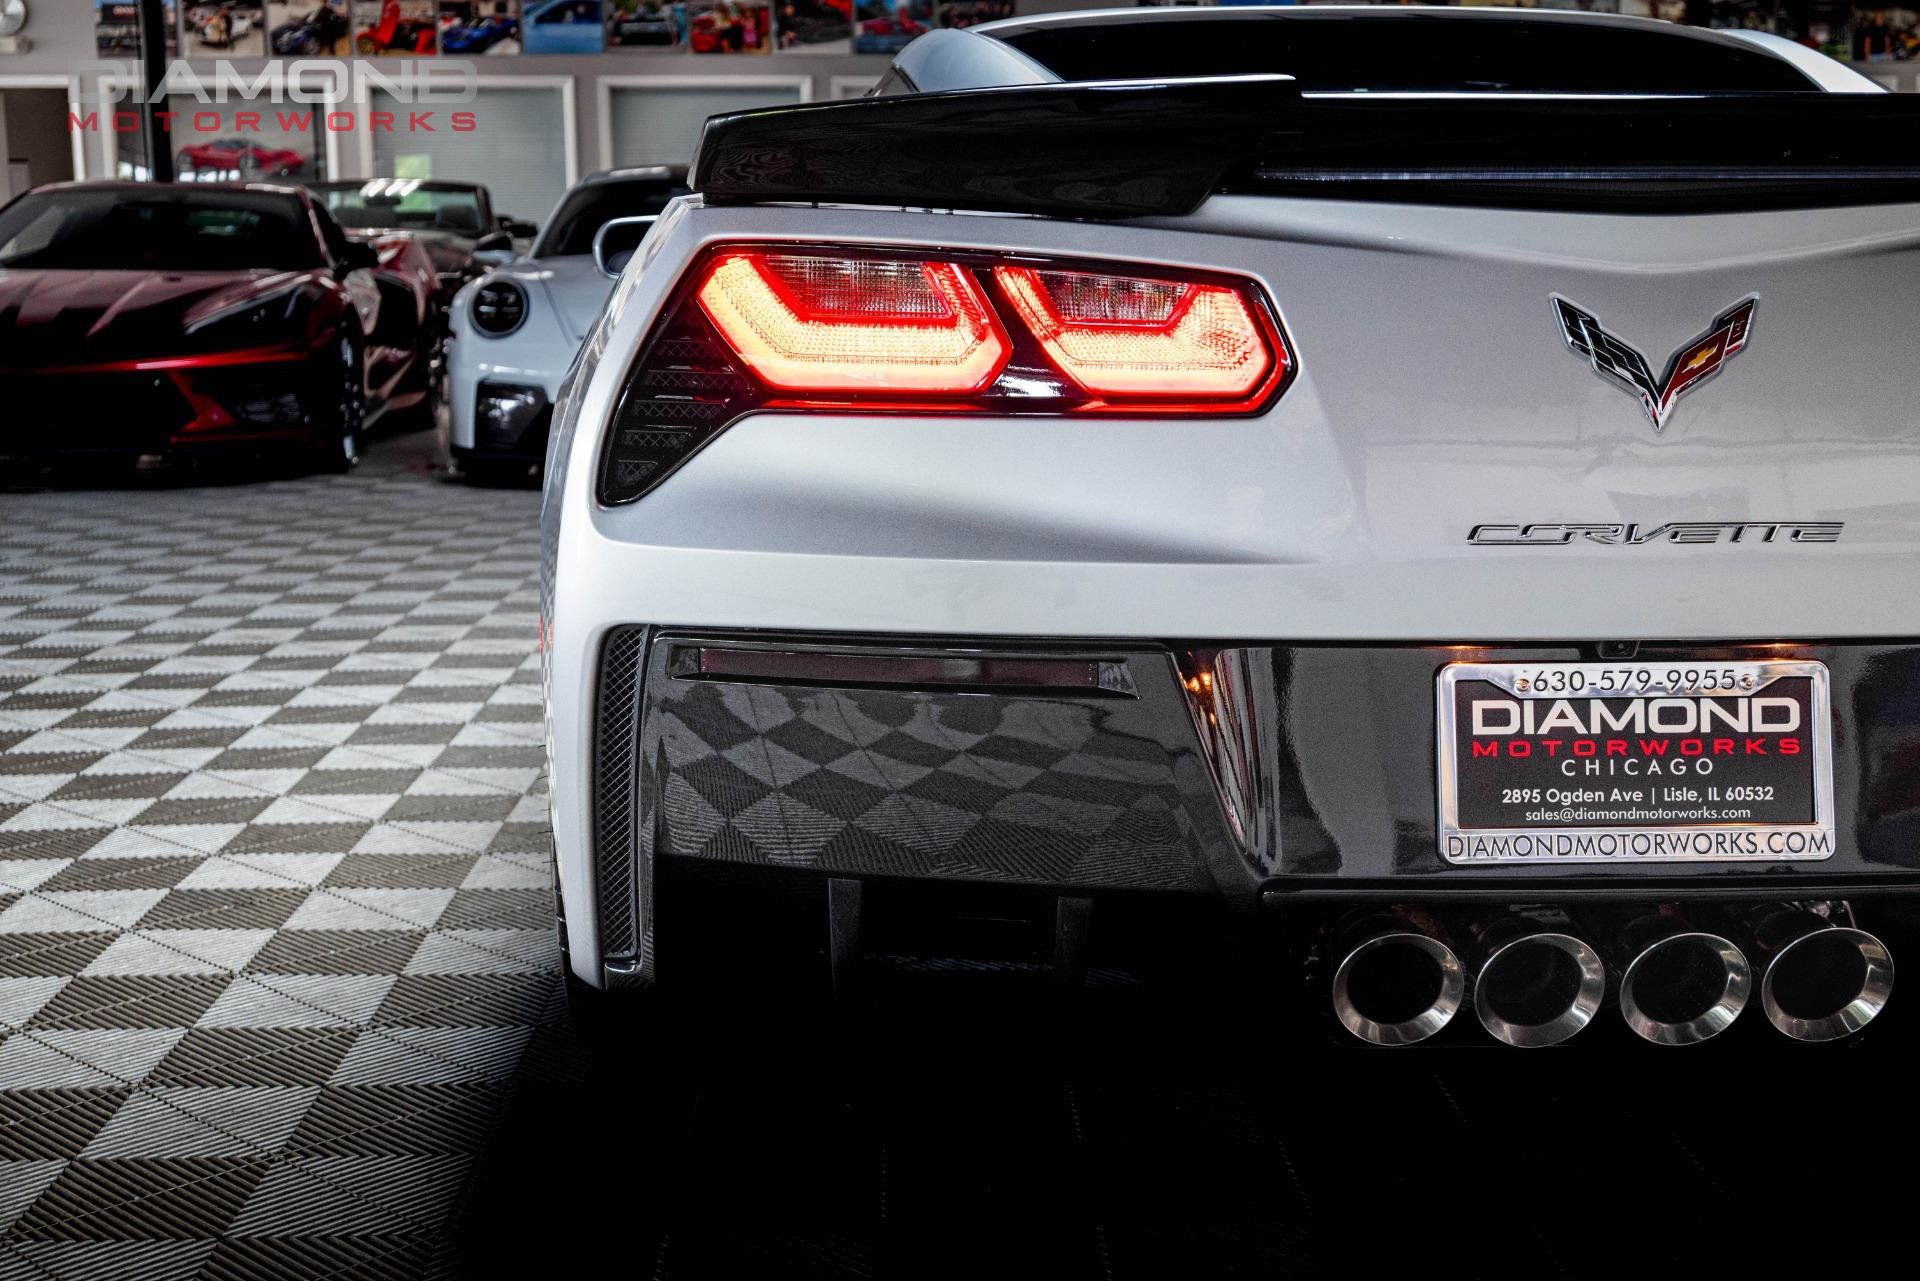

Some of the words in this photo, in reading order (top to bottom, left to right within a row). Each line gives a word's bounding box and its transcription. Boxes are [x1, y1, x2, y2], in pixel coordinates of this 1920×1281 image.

[1466, 522, 1845, 545] CORVETTE
[1533, 669, 1737, 692] 630-579-9955
[1472, 697, 1801, 735] DIAMOND
[1472, 737, 1801, 758] MOTORWORKS
[1561, 758, 1714, 776] CHICAGO
[1501, 789, 1541, 804] 2895
[1546, 788, 1606, 806] Ogden
[1610, 789, 1644, 802] Ave
[1663, 786, 1704, 804] Lisle,
[1708, 787, 1721, 802] IL
[1725, 786, 1774, 802] 60532
[1525, 806, 1751, 823] sales@diamondmotorworks.com
[1448, 832, 1831, 858] DIAMONDMOTORWORKS.COM
